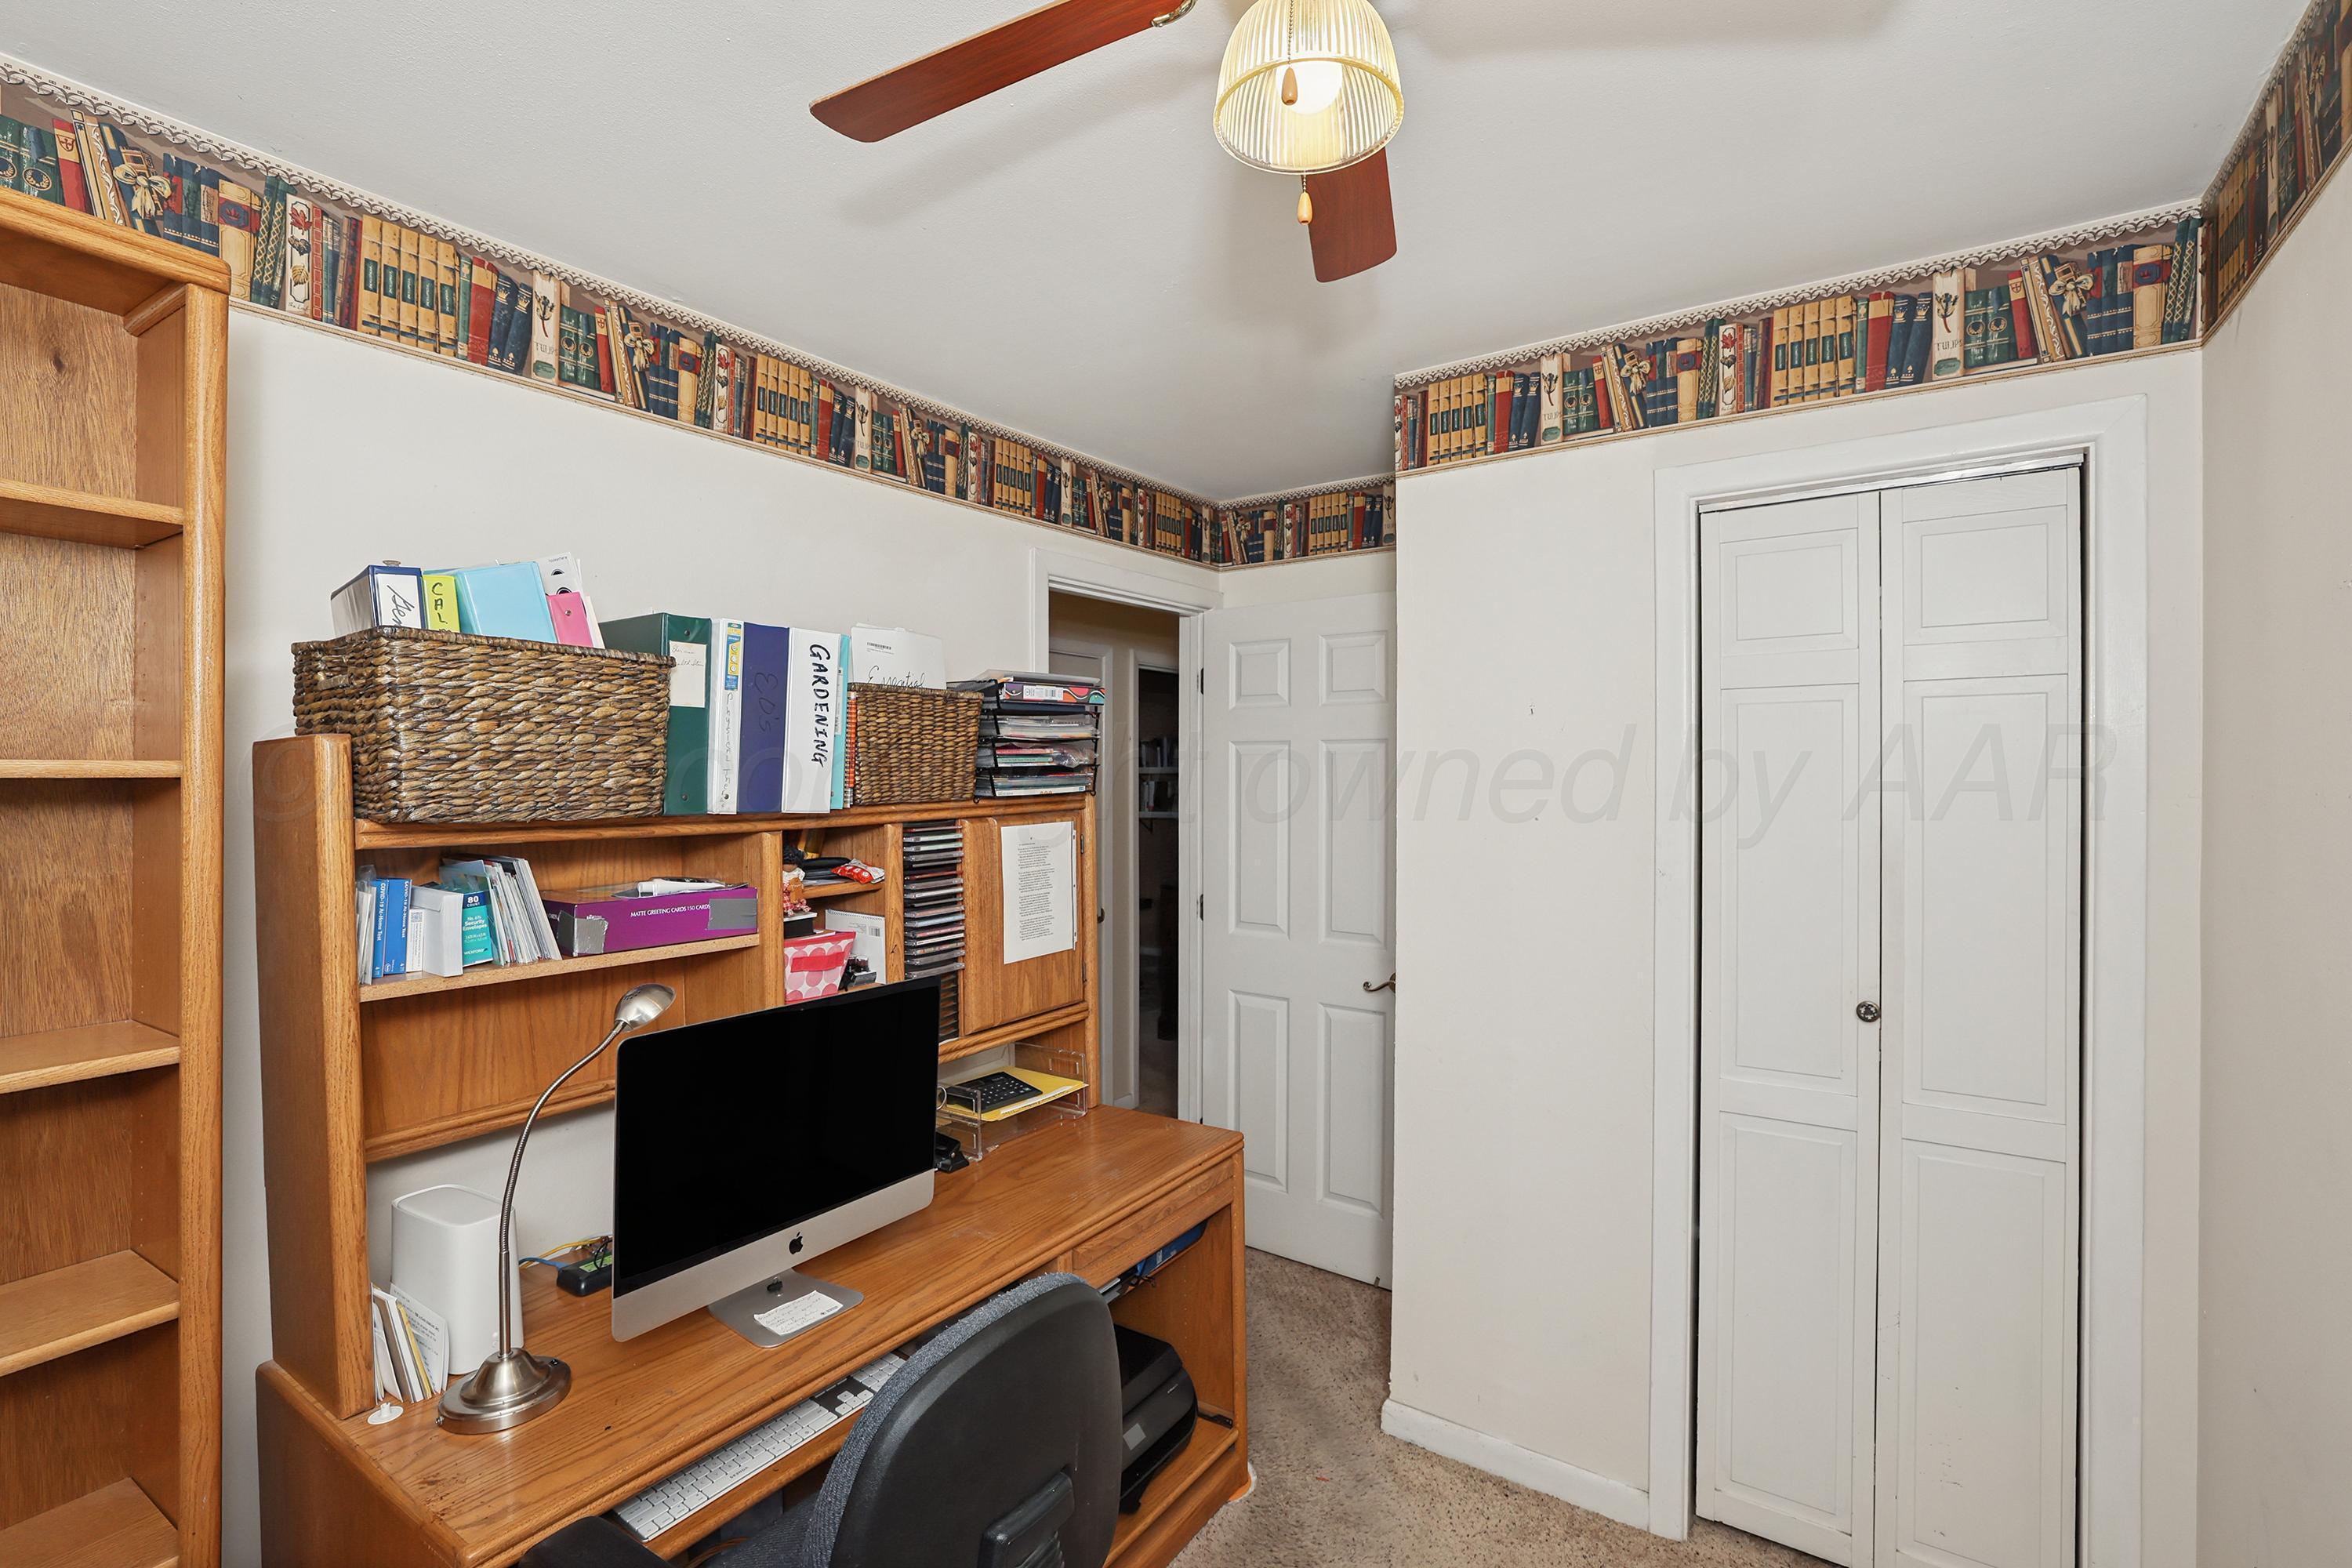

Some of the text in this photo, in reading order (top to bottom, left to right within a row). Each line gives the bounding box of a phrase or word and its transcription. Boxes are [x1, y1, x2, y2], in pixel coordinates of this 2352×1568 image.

[809, 644, 831, 768] GARDENING
[467, 895, 479, 904] 80
[647, 907, 671, 916] GREETING
